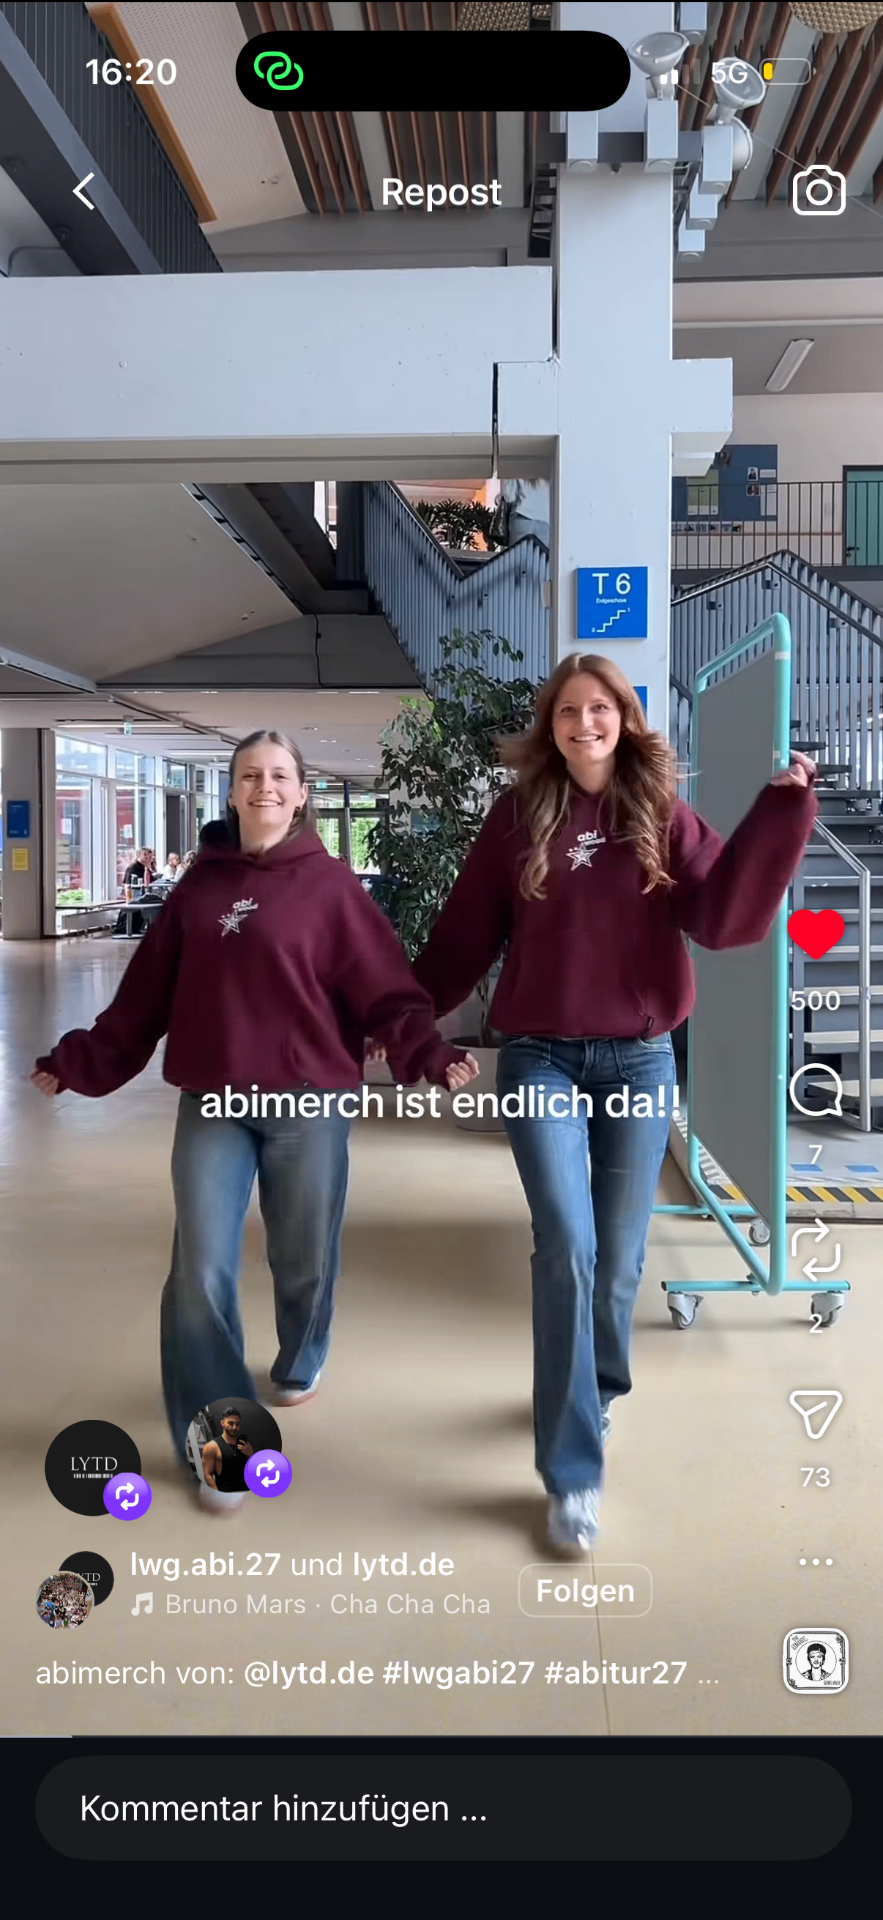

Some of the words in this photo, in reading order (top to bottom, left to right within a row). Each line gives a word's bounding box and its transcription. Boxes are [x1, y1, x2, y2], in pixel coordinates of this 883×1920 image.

[592, 573, 609, 595] T
[615, 573, 631, 595] 6
[577, 829, 598, 843] abi
[232, 897, 254, 910] abi
